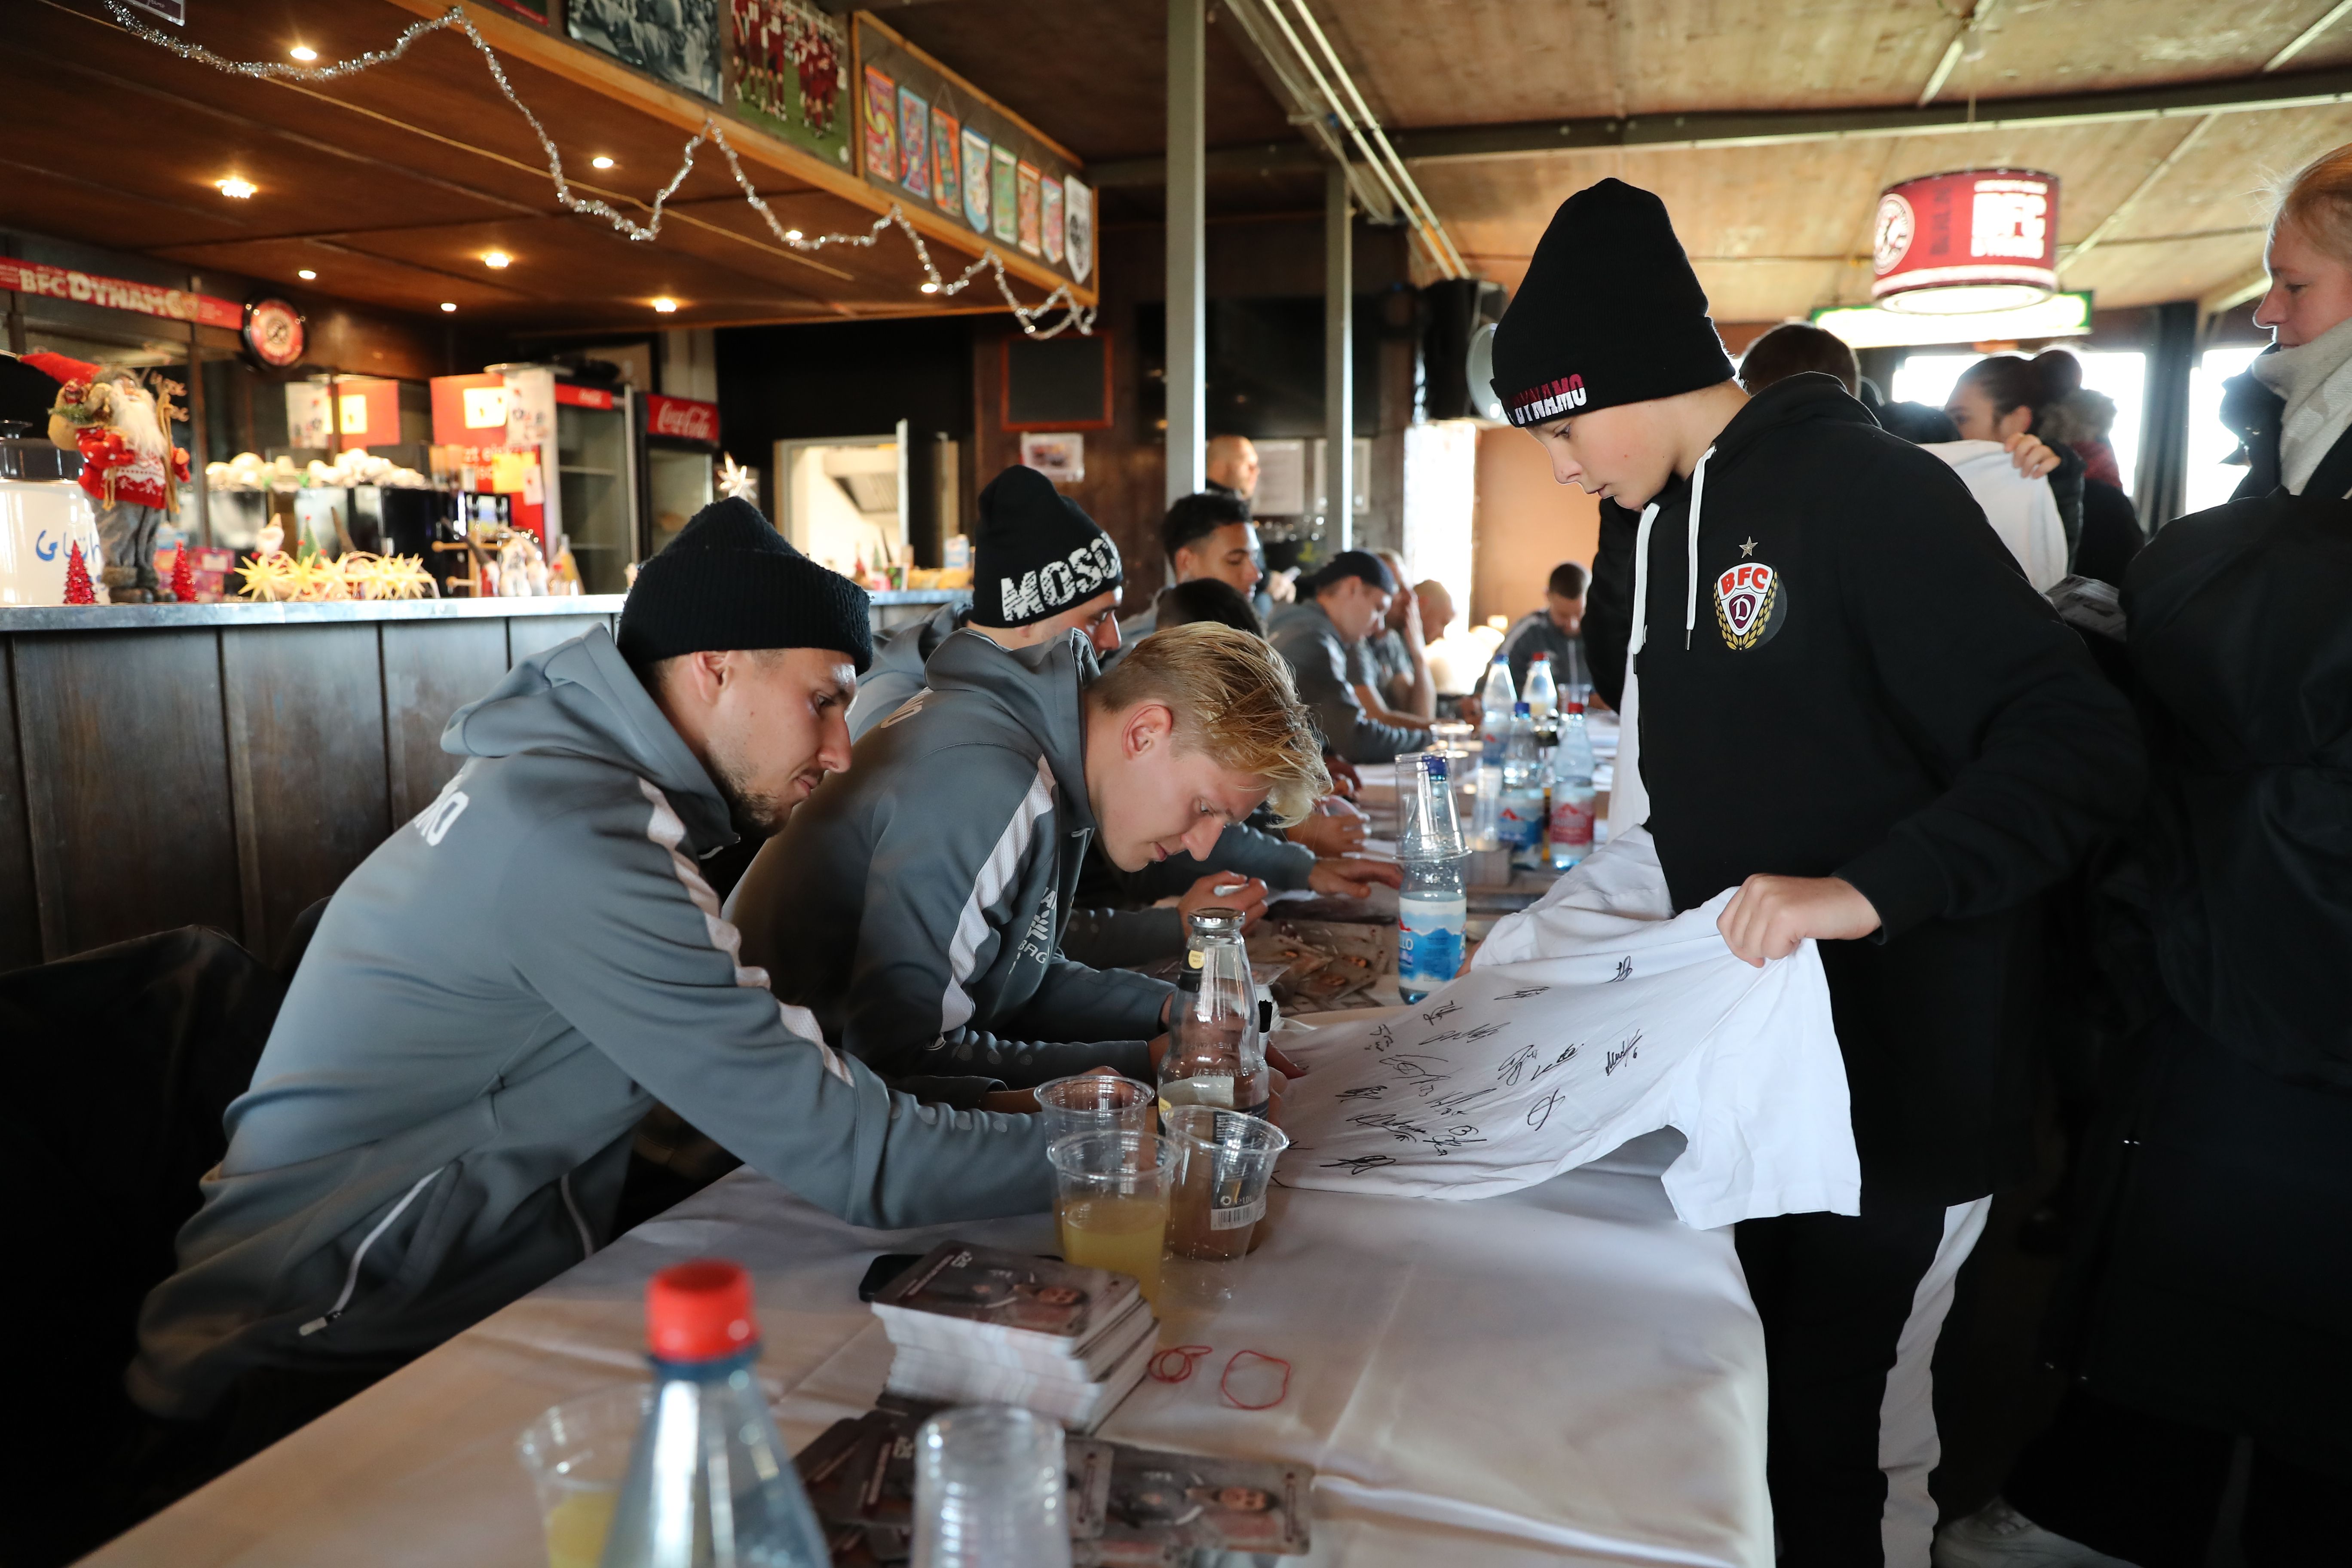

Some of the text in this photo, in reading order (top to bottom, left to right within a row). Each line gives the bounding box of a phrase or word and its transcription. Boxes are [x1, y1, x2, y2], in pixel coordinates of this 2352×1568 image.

[19, 268, 67, 297] BFC
[67, 272, 183, 319] DYNAMO
[1512, 373, 1587, 425] DYNAMO
[1721, 566, 1769, 596] BFC
[1732, 595, 1752, 621] D
